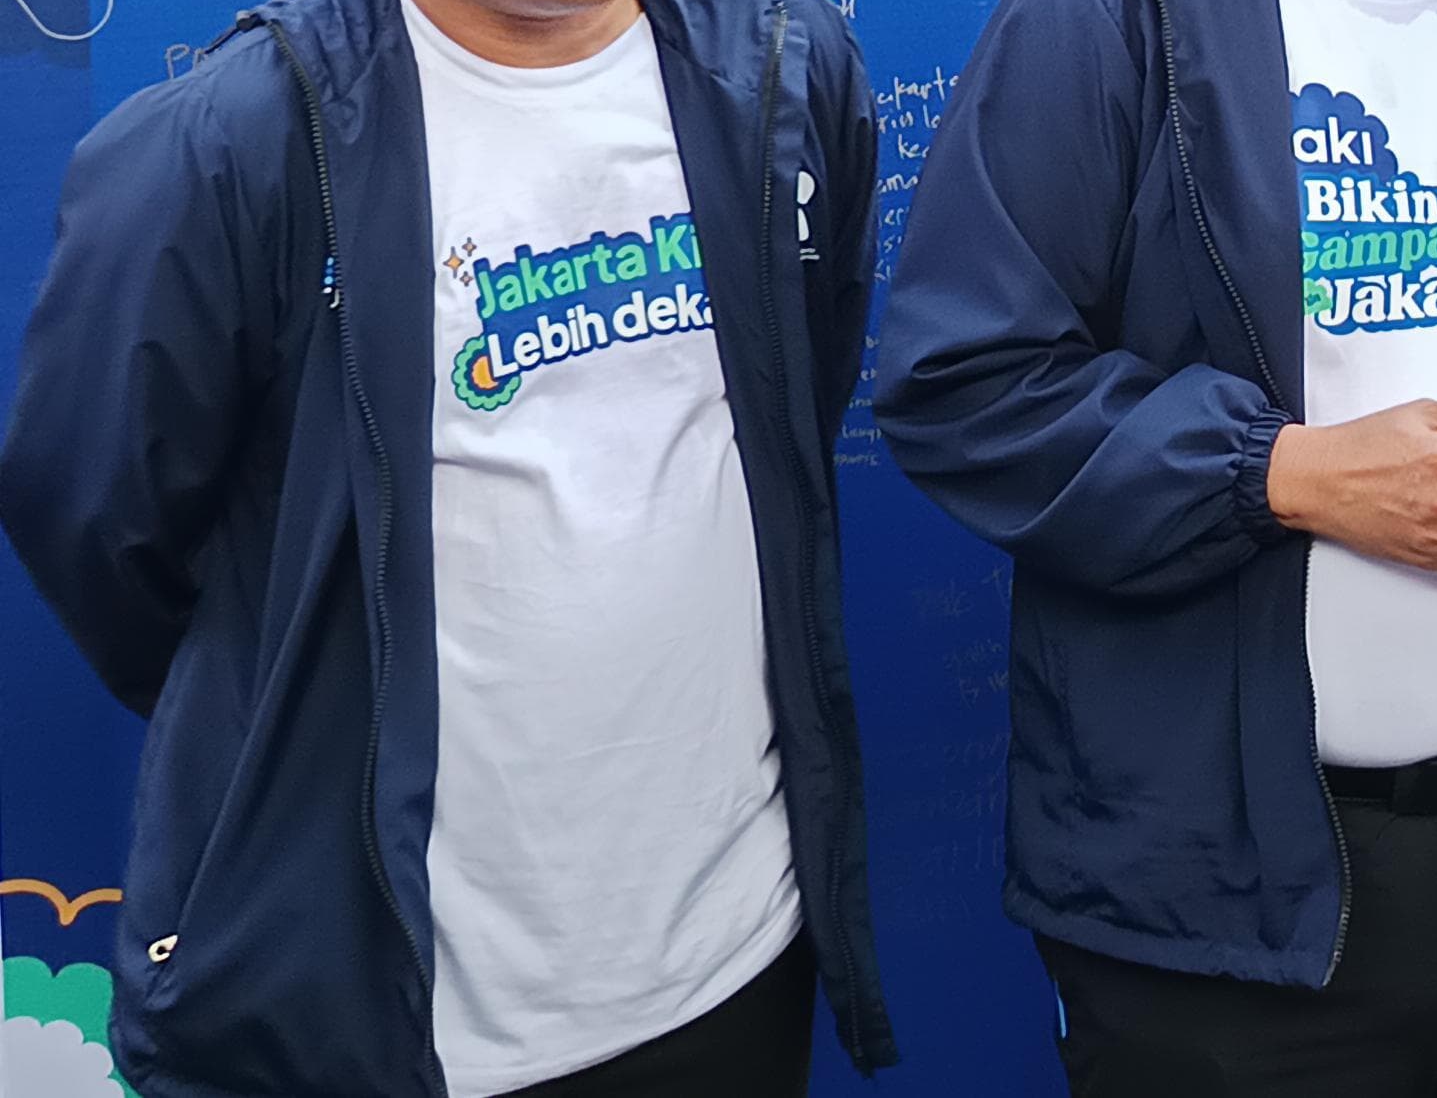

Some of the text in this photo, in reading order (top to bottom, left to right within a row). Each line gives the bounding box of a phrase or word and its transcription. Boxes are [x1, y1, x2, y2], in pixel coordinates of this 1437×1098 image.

[1291, 116, 1376, 167] aki
[475, 222, 703, 320] Jakarta Ki
[486, 303, 610, 379] Lebih
